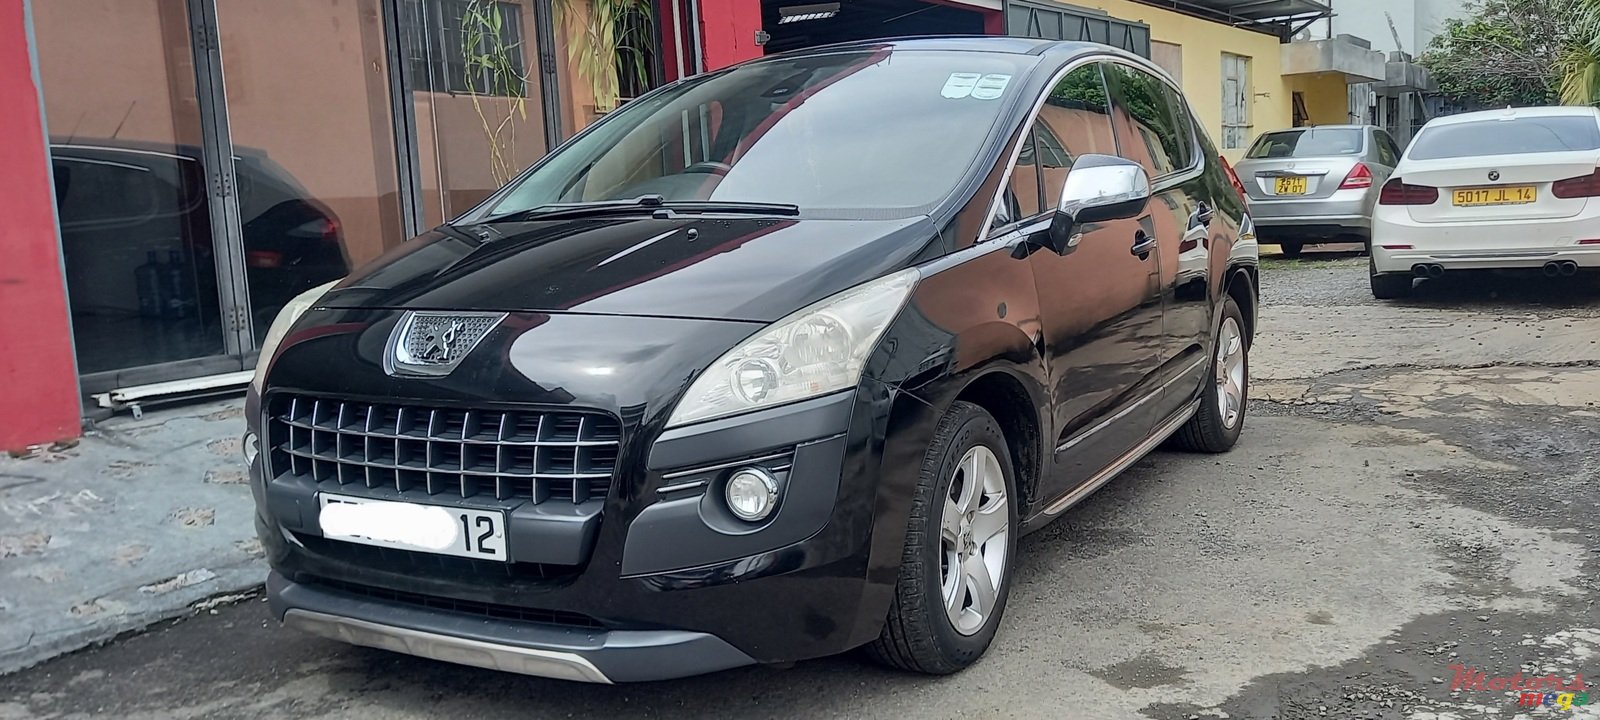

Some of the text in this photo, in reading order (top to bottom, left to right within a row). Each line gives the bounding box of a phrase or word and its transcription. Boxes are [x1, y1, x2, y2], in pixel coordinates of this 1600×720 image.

[1292, 185, 1303, 193] 07
[1457, 188, 1531, 203] 5017 JL 14
[460, 514, 496, 555] 12
